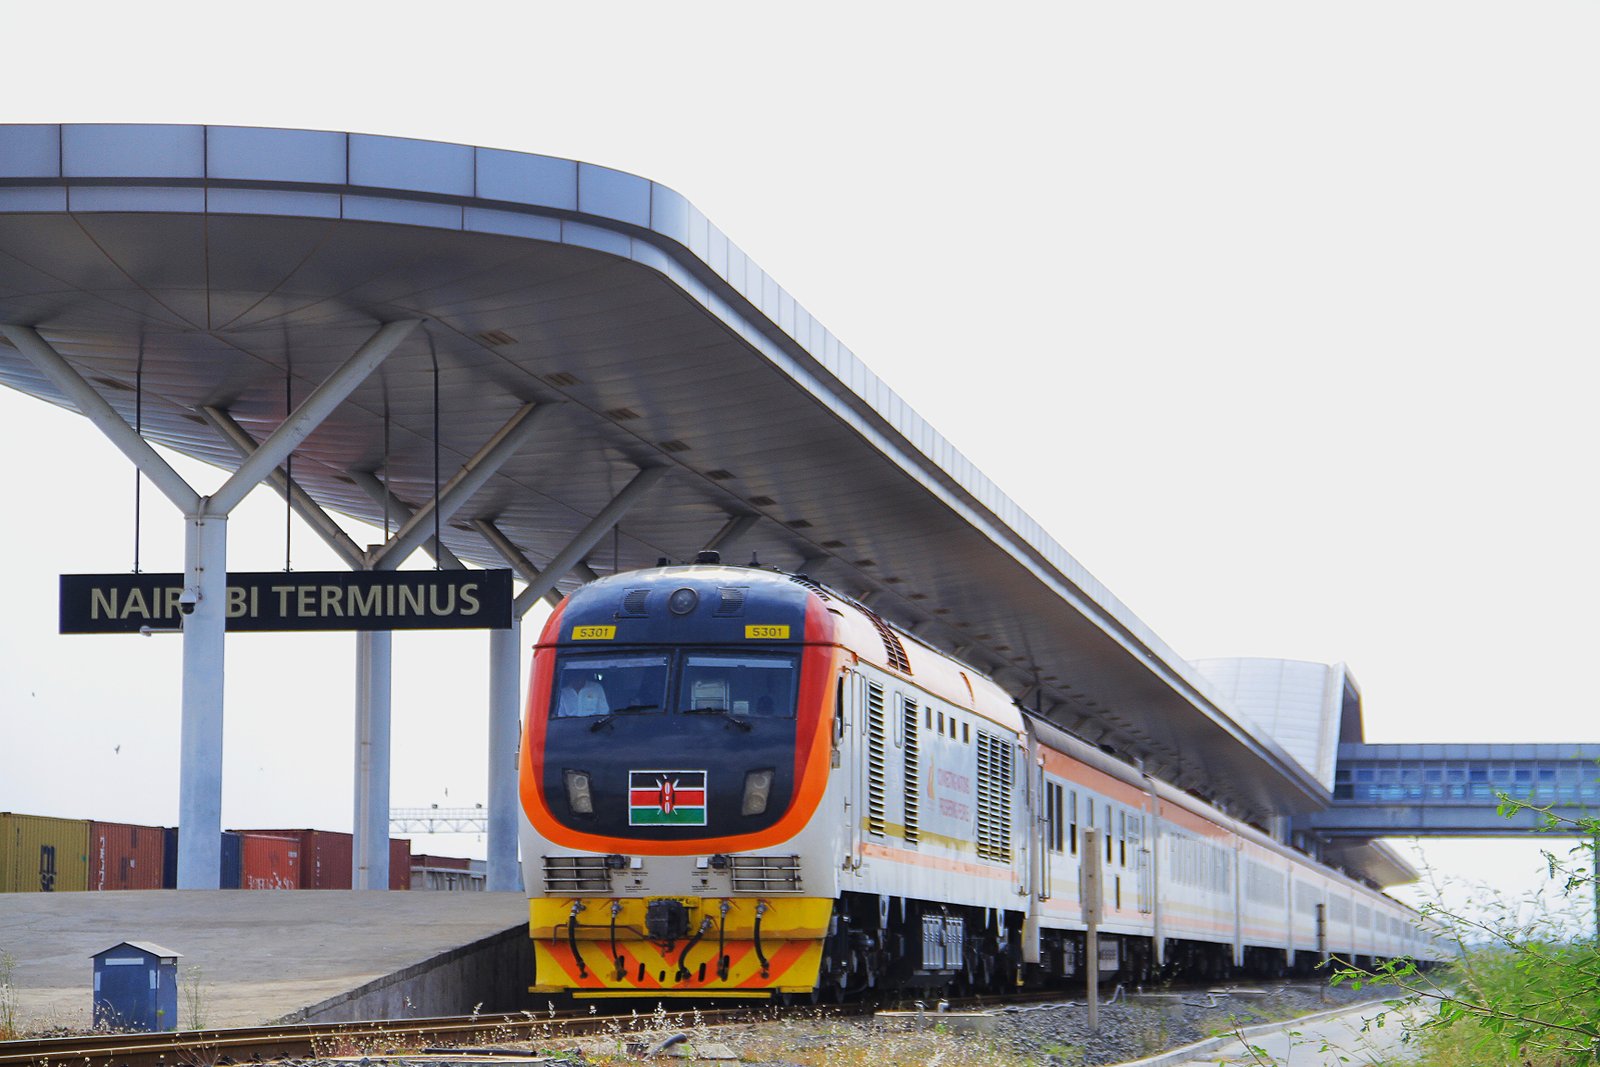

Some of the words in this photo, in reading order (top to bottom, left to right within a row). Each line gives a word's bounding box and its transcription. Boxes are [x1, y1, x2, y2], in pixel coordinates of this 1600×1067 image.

[91, 587, 258, 619] NAIRBI
[271, 583, 480, 617] TERMINUS
[753, 627, 782, 638] 5301
